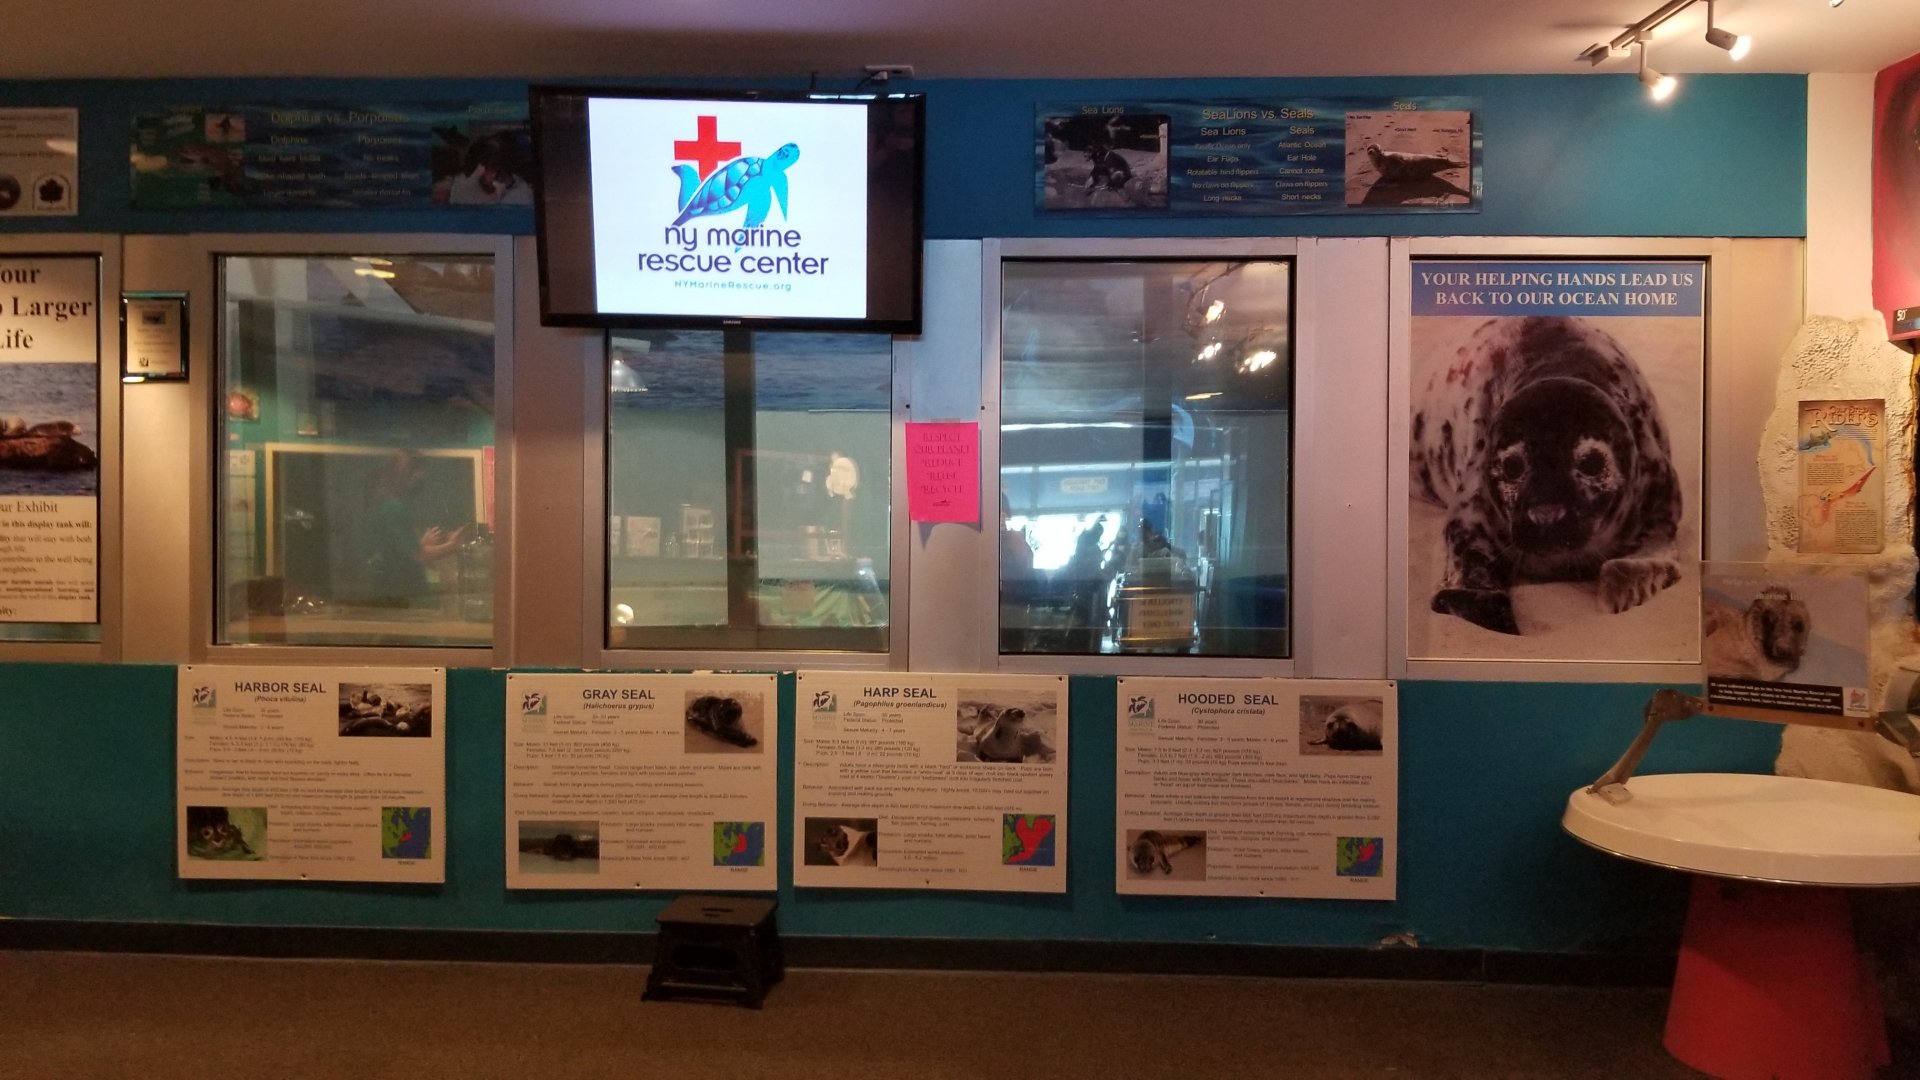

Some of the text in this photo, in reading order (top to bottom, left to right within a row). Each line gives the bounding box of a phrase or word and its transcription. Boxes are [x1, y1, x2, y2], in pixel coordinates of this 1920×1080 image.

[1081, 105, 1124, 114] Sea Lions
[1393, 101, 1417, 111] Seals
[1280, 107, 1314, 119] Seals
[1200, 128, 1247, 136] Sea Lions
[1289, 126, 1315, 135] Seals
[665, 224, 802, 252] ny marine
[638, 252, 830, 275] rescue center
[0, 269, 41, 284] our
[1421, 272, 1693, 286] YOUR HELPING HANDS LEAD US
[674, 280, 791, 292] NYMarineRescue.org
[1436, 291, 1678, 305] BACK TO OUR OCEAN HOME
[13, 296, 93, 322] Larger
[1, 329, 33, 349] ife
[0, 501, 58, 513] ur Exhibit
[27, 520, 53, 530] display
[56, 520, 74, 528] tank
[235, 681, 327, 694] HARBOR SEAL
[863, 687, 938, 699] HARP SEAL
[582, 689, 656, 700] GRAY SEAL
[1178, 693, 1279, 706] HOODED SEAL
